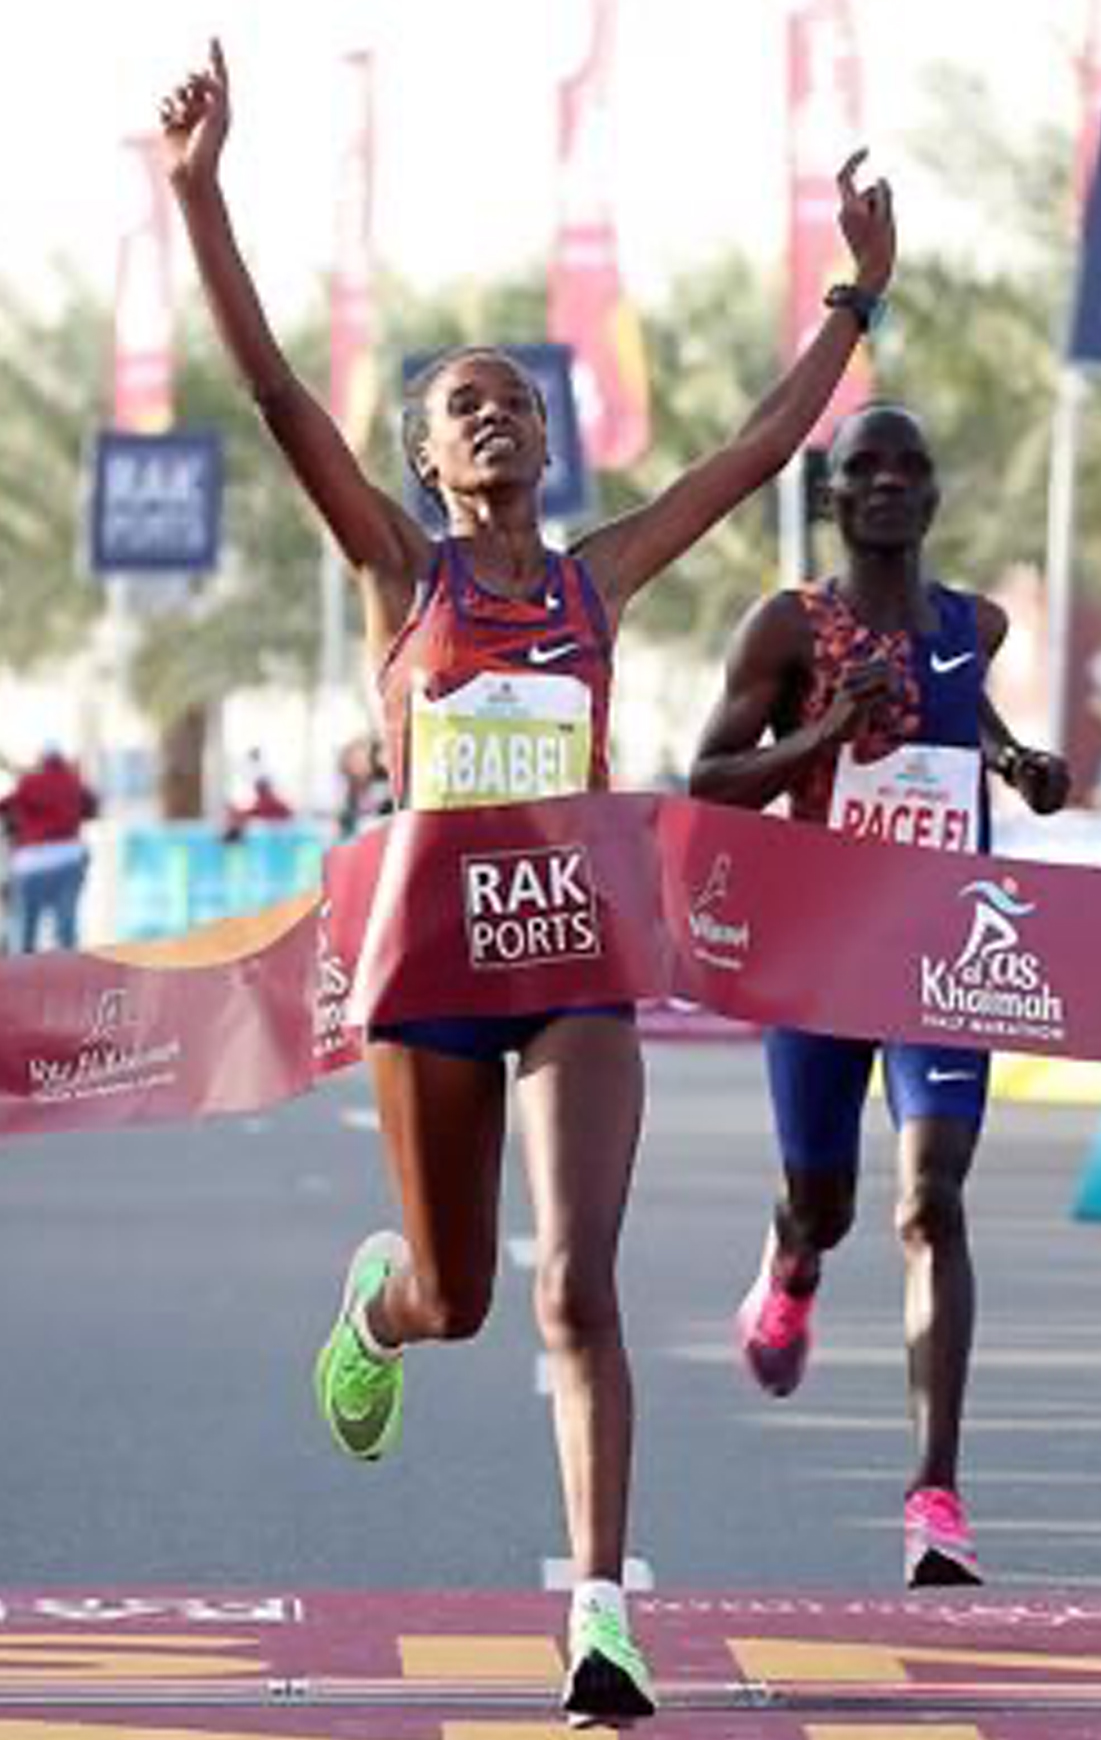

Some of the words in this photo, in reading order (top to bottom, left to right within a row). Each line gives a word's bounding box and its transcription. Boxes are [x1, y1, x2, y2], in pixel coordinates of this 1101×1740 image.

[468, 853, 587, 915] RAK
[472, 912, 595, 960] PORTS
[921, 954, 1063, 1022] Khaimah
